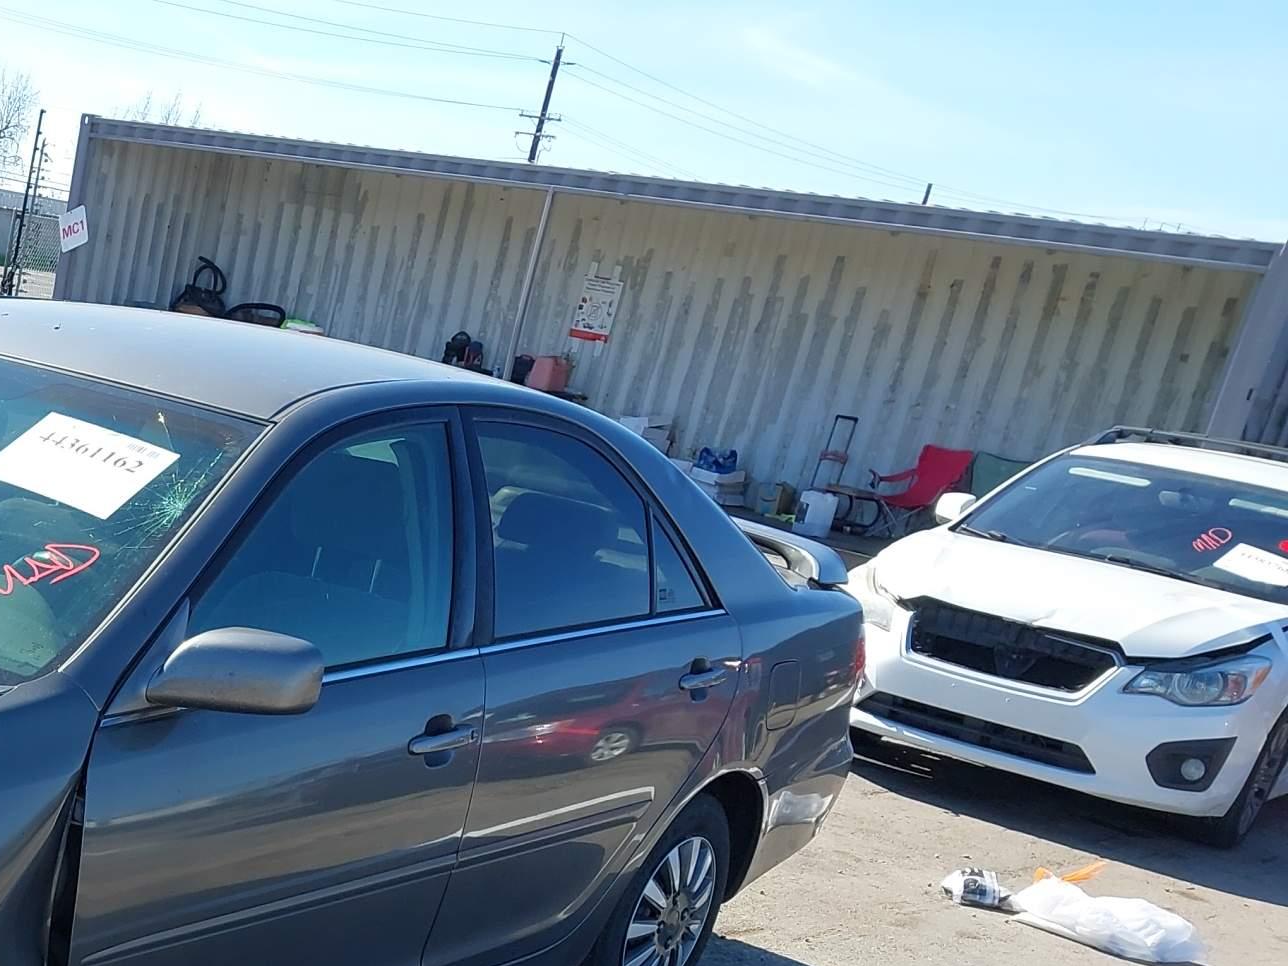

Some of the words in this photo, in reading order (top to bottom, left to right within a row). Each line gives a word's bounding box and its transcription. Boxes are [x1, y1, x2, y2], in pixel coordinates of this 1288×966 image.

[62, 220, 85, 240] MC1
[39, 432, 144, 473] 44361162
[1192, 527, 1233, 553] MAD
